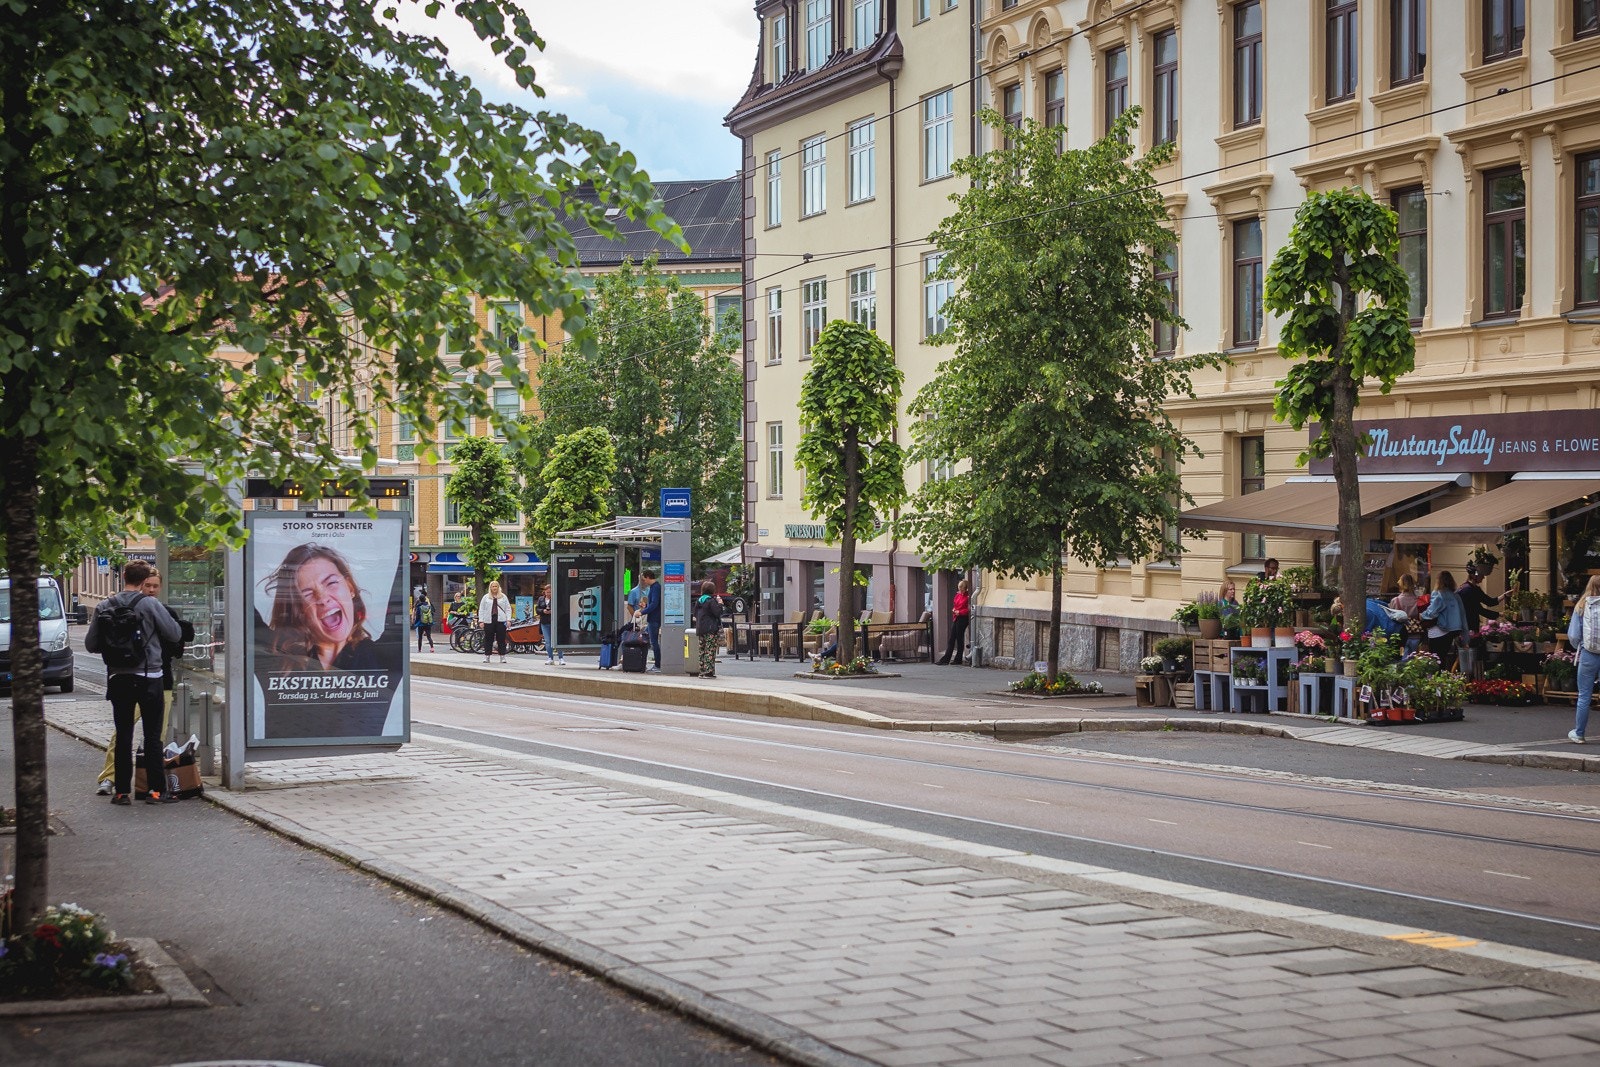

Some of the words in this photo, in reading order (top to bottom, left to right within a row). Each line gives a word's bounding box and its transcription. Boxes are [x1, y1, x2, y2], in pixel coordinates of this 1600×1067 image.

[1498, 440, 1537, 454] JEANS
[1542, 440, 1550, 452] &
[1555, 438, 1599, 452] FLOWE
[282, 522, 314, 530] STORO
[316, 522, 373, 530] STORSENTER
[784, 524, 814, 539] ESPRESSO
[268, 675, 389, 690] EKSTREMSALG
[278, 692, 309, 700] Torsdag
[325, 690, 352, 700] Lørdag
[362, 690, 379, 700] juni
